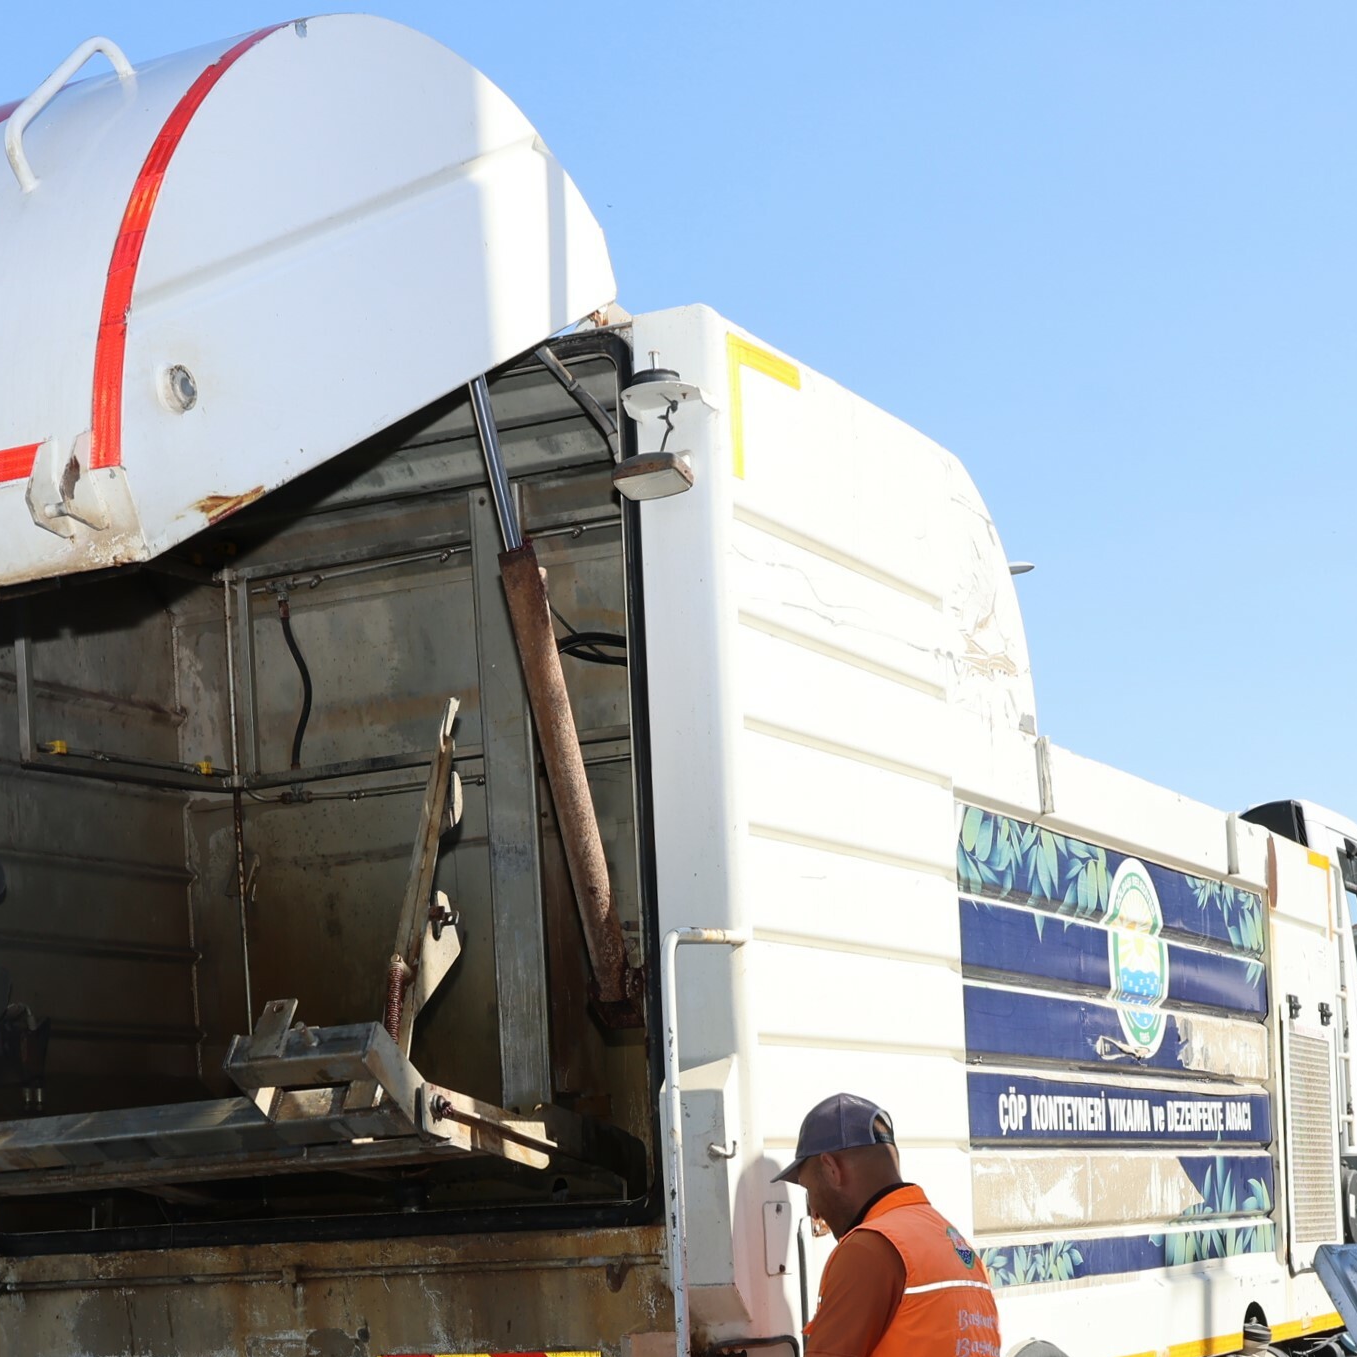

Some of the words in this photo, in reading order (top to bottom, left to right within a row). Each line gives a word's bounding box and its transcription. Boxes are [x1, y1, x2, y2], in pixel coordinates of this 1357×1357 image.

[999, 1087, 1027, 1135] ÇÖP
[1031, 1091, 1106, 1131] KONTEYNERİ
[1108, 1098, 1151, 1132] YIKAMA
[1152, 1105, 1165, 1132] ve
[1167, 1101, 1224, 1132] DEZENFEKTE
[1226, 1102, 1251, 1131] ARACI
